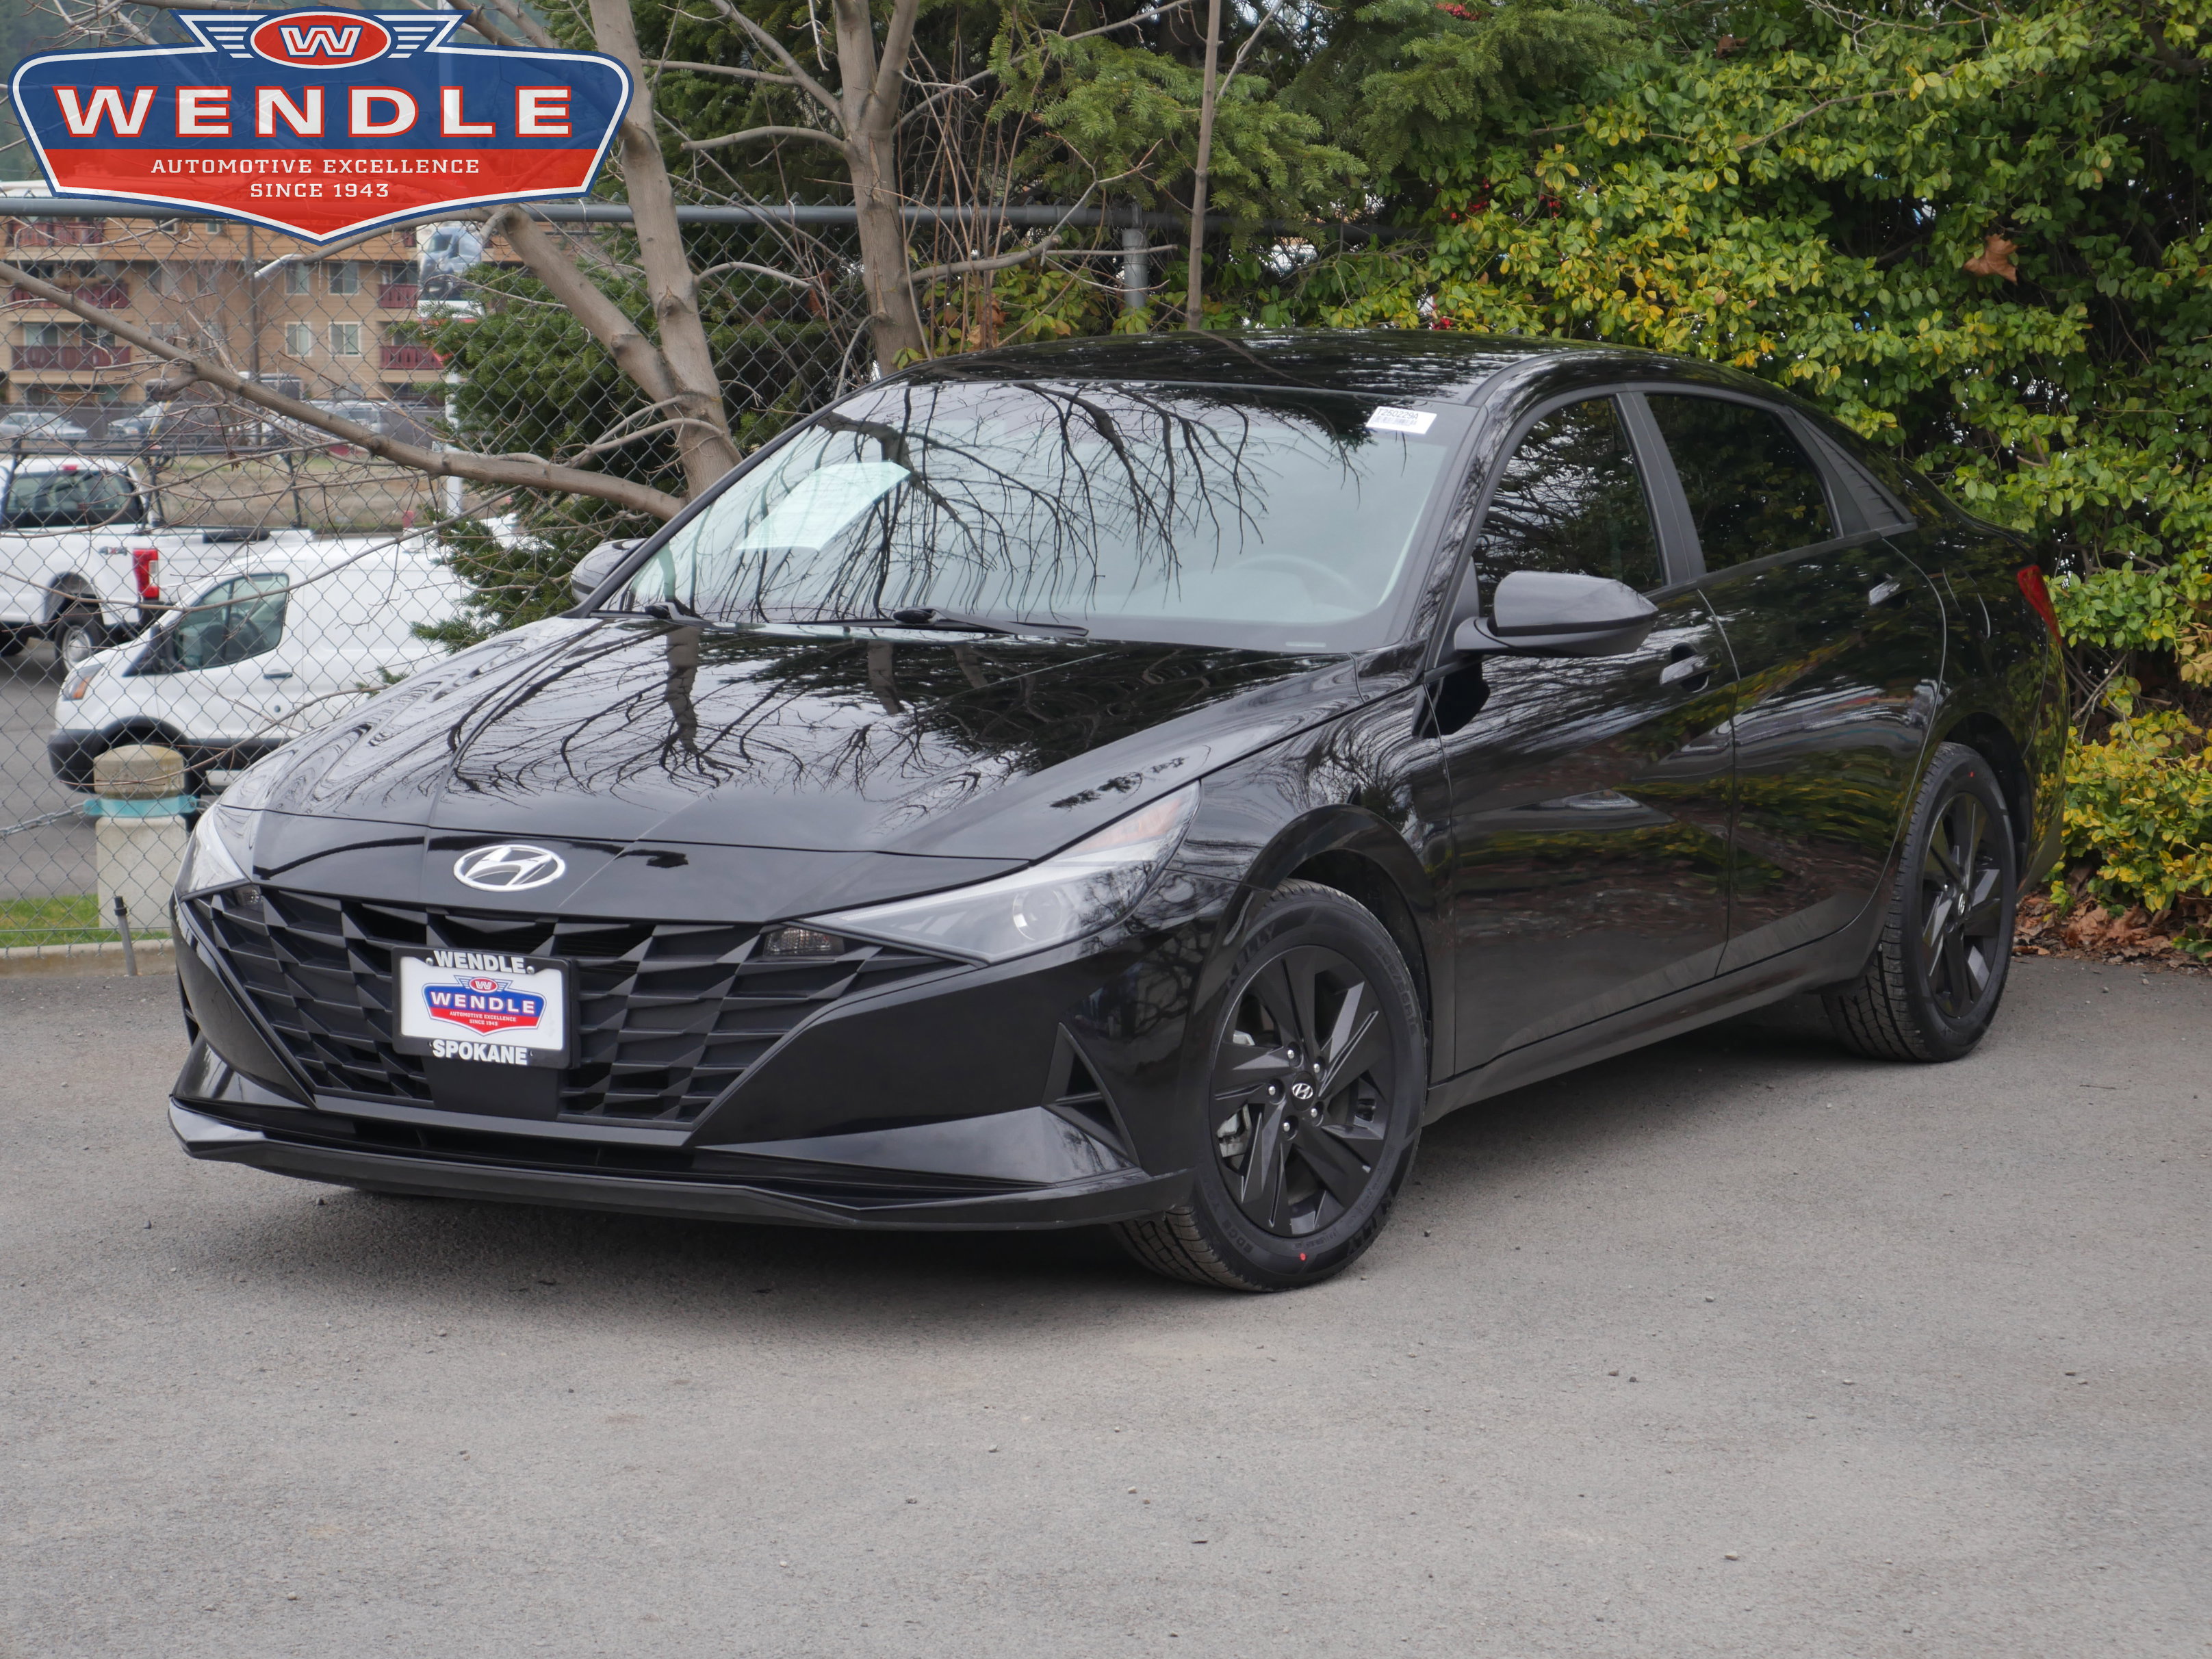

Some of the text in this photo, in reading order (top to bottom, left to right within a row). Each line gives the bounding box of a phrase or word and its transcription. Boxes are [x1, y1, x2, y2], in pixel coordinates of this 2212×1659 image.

[1378, 408, 1419, 420] T250229A
[433, 950, 527, 974] WENDLE
[430, 991, 535, 1014] WENDLE
[449, 1011, 483, 1019] AUTOMOTIVE
[432, 1039, 528, 1066] SPOKANE
